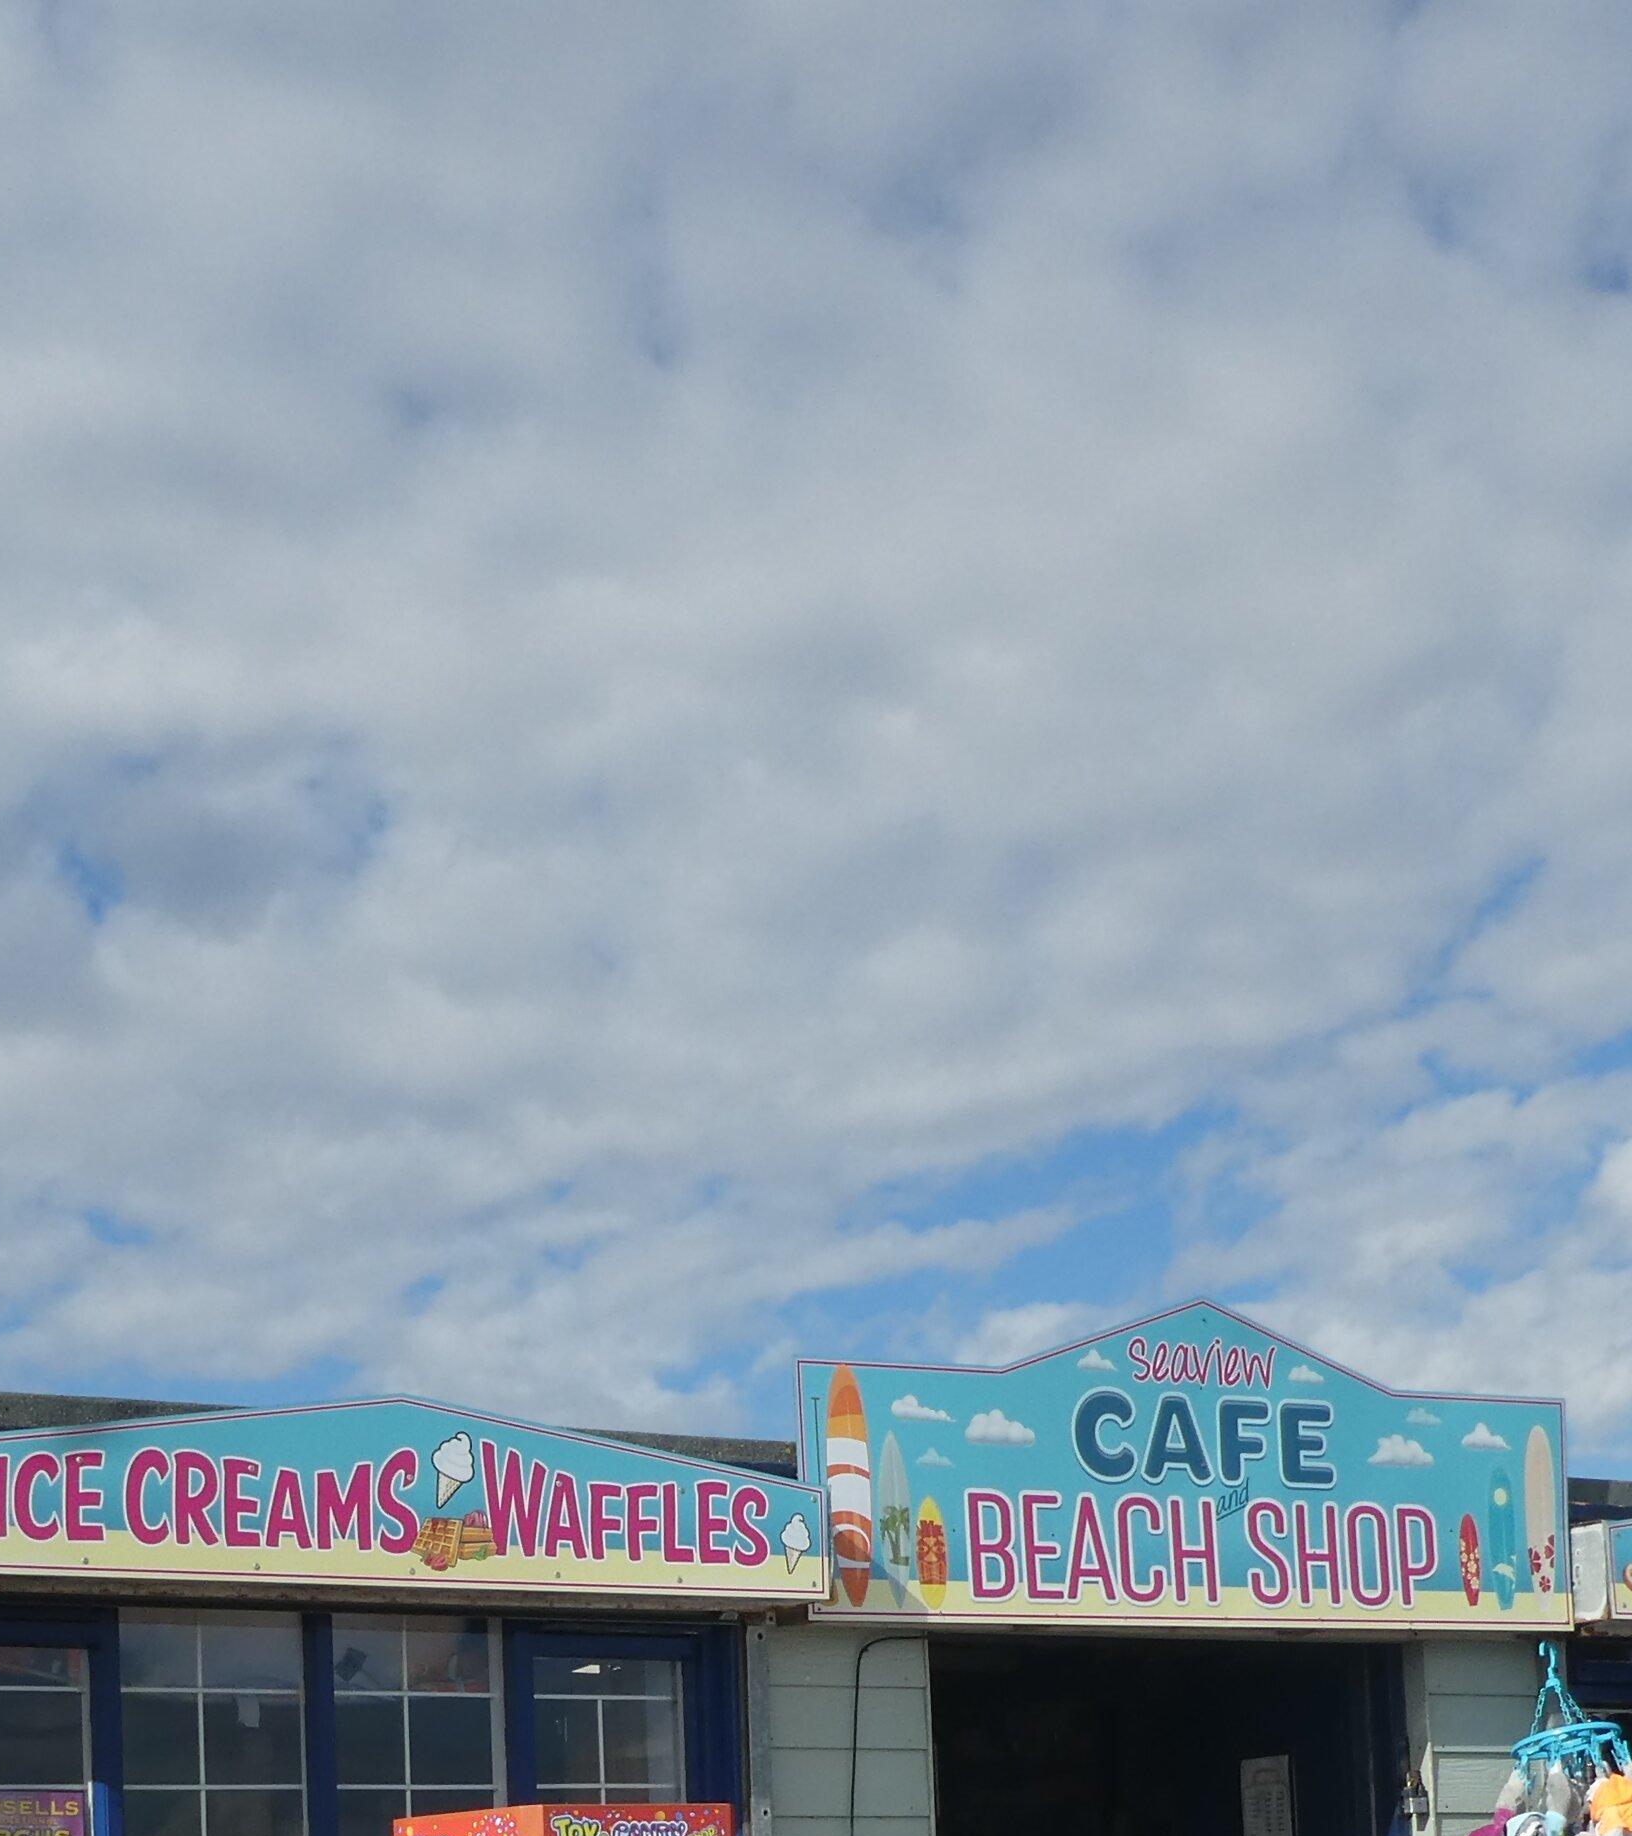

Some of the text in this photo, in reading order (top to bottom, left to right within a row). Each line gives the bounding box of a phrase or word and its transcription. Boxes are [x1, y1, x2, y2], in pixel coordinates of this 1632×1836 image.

[1073, 1389, 1336, 1488] CAFE
[124, 1447, 419, 1554] CREAMS
[479, 1438, 770, 1569] WAFFLES
[966, 1490, 1437, 1610] BEACH SHOP
[1216, 1477, 1249, 1519] and
